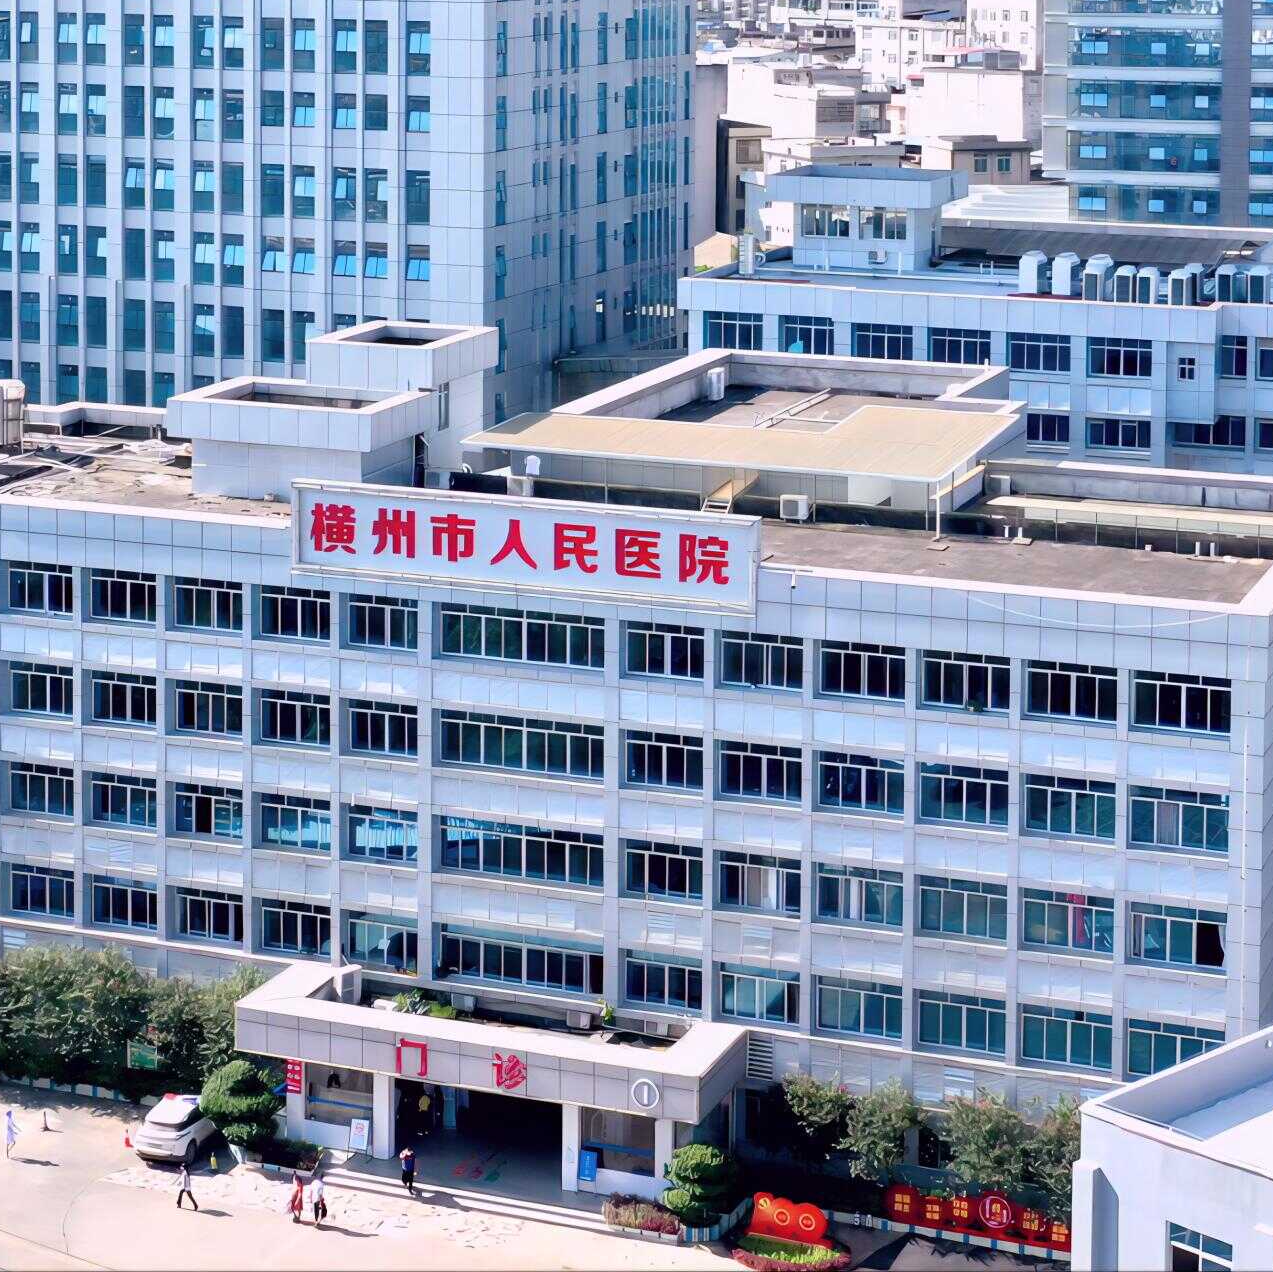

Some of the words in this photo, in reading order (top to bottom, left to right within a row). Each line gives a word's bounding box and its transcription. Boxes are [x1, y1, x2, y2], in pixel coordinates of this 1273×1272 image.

[310, 502, 730, 585] 横州市人民医院
[394, 1037, 527, 1090] 门诊
